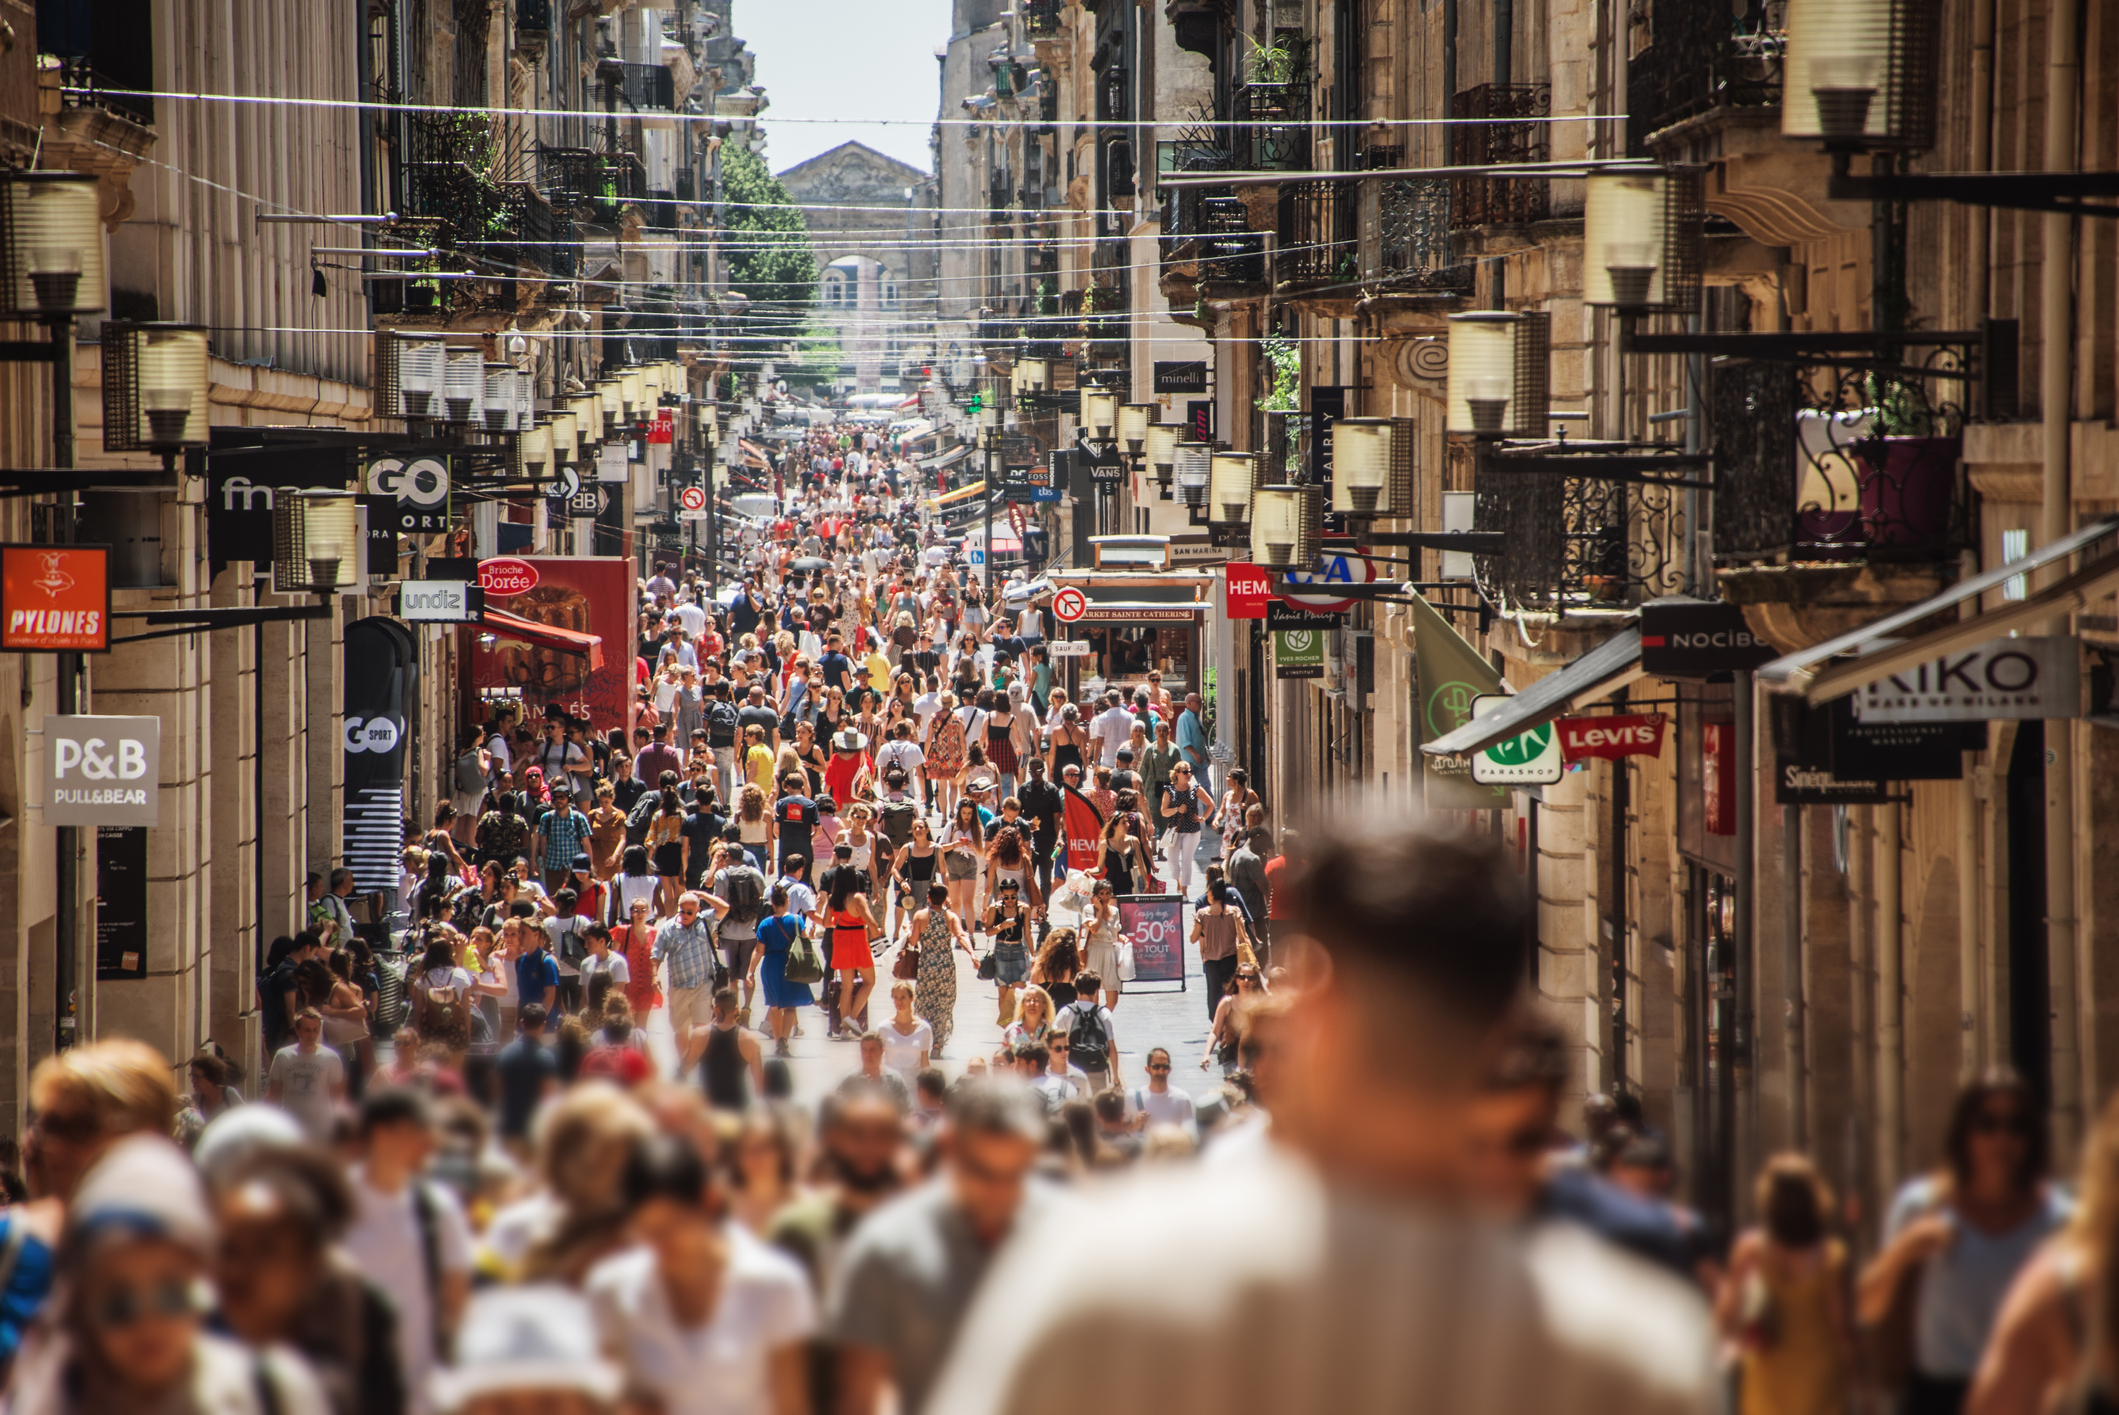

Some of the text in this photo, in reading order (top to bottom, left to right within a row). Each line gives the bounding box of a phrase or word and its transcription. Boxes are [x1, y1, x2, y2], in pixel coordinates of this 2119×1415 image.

[1161, 371, 1200, 384] minelli
[646, 420, 671, 432] SFR
[1194, 409, 1207, 442] am
[1323, 411, 1334, 483] FAIRLY
[1090, 466, 1121, 478] VANS
[367, 458, 449, 505] GO
[1038, 486, 1054, 496] tbs
[488, 565, 524, 575] Brioche
[480, 574, 530, 589] Dorée
[1229, 580, 1271, 595] HEM
[405, 590, 461, 609] undiz
[9, 609, 101, 635] PYLONES
[1273, 609, 1301, 621] Janie
[1963, 695, 2040, 706] MILANO
[344, 716, 398, 754] GO
[369, 730, 392, 740] SPORT
[55, 738, 147, 780] P&B
[55, 789, 147, 805] PULL&BEAR
[1127, 920, 1176, 943] -50%
[1144, 945, 1170, 953] TOUT
